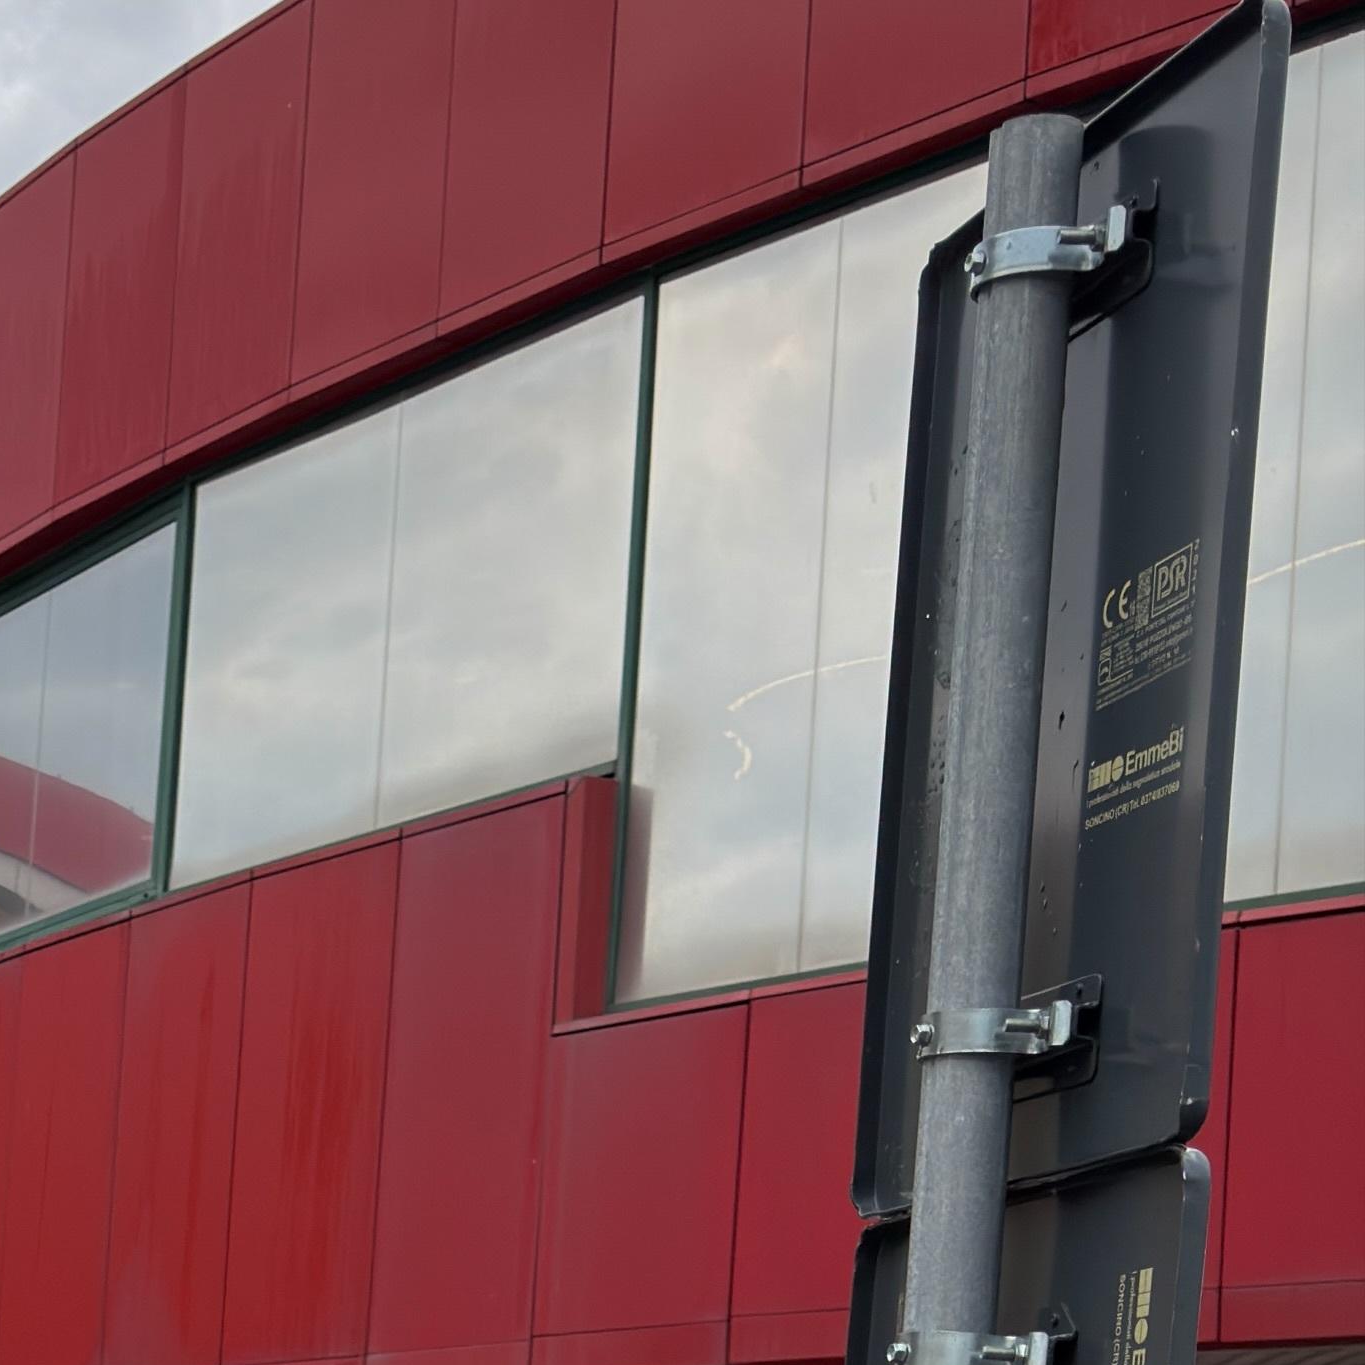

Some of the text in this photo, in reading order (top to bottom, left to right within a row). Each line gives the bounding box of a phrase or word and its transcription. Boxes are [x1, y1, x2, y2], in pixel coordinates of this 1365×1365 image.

[1157, 554, 1188, 602] PSR
[1103, 580, 1131, 629] CE
[1125, 726, 1184, 776] EmmeBi
[1085, 809, 1115, 828] SONCINO
[1115, 1274, 1126, 1336] SONCINO
